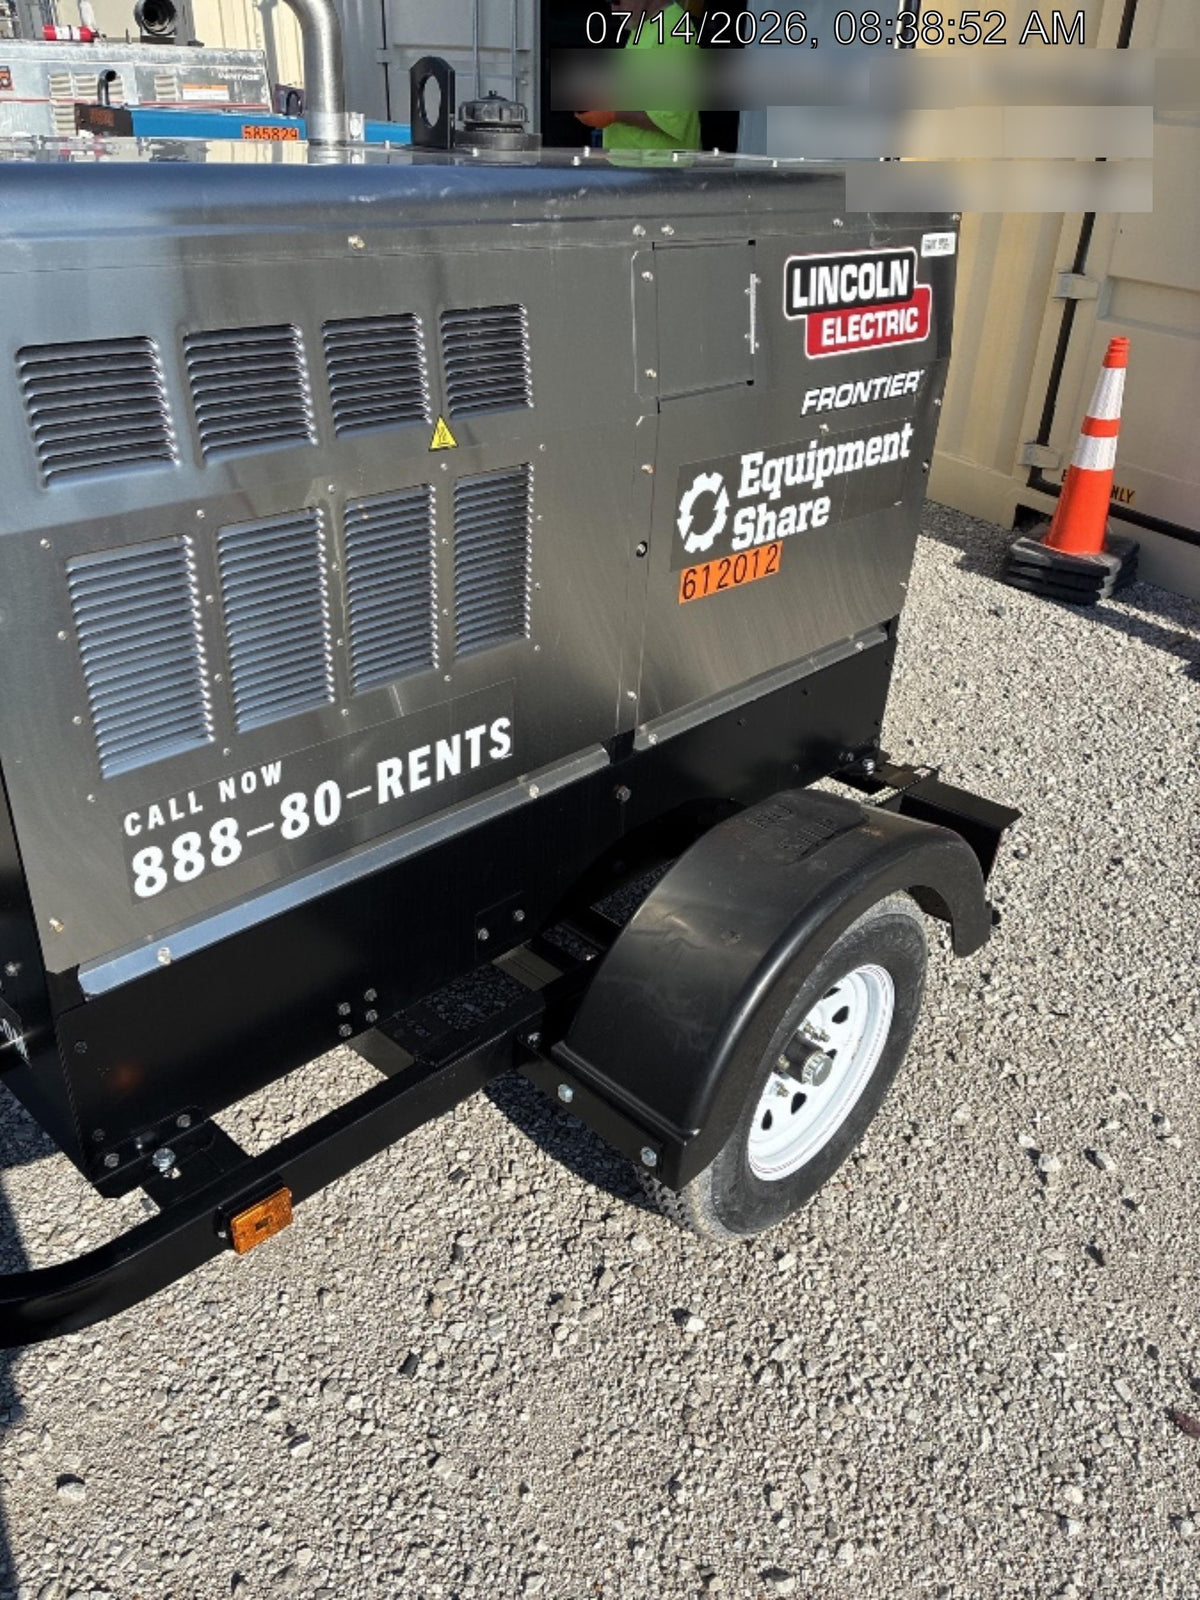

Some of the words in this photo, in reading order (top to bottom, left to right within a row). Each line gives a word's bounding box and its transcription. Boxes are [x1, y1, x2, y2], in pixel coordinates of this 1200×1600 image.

[244, 125, 298, 141] 585829
[792, 258, 910, 309] LINCOLN
[821, 307, 919, 348] ELECTRIC
[800, 371, 920, 415] FRONTIER
[737, 422, 914, 500] Equipment
[731, 495, 831, 551] Share
[681, 543, 779, 601] 612012
[123, 790, 204, 838] CALL
[218, 760, 283, 803] NOW
[131, 717, 513, 900] 888-80-RENTS
